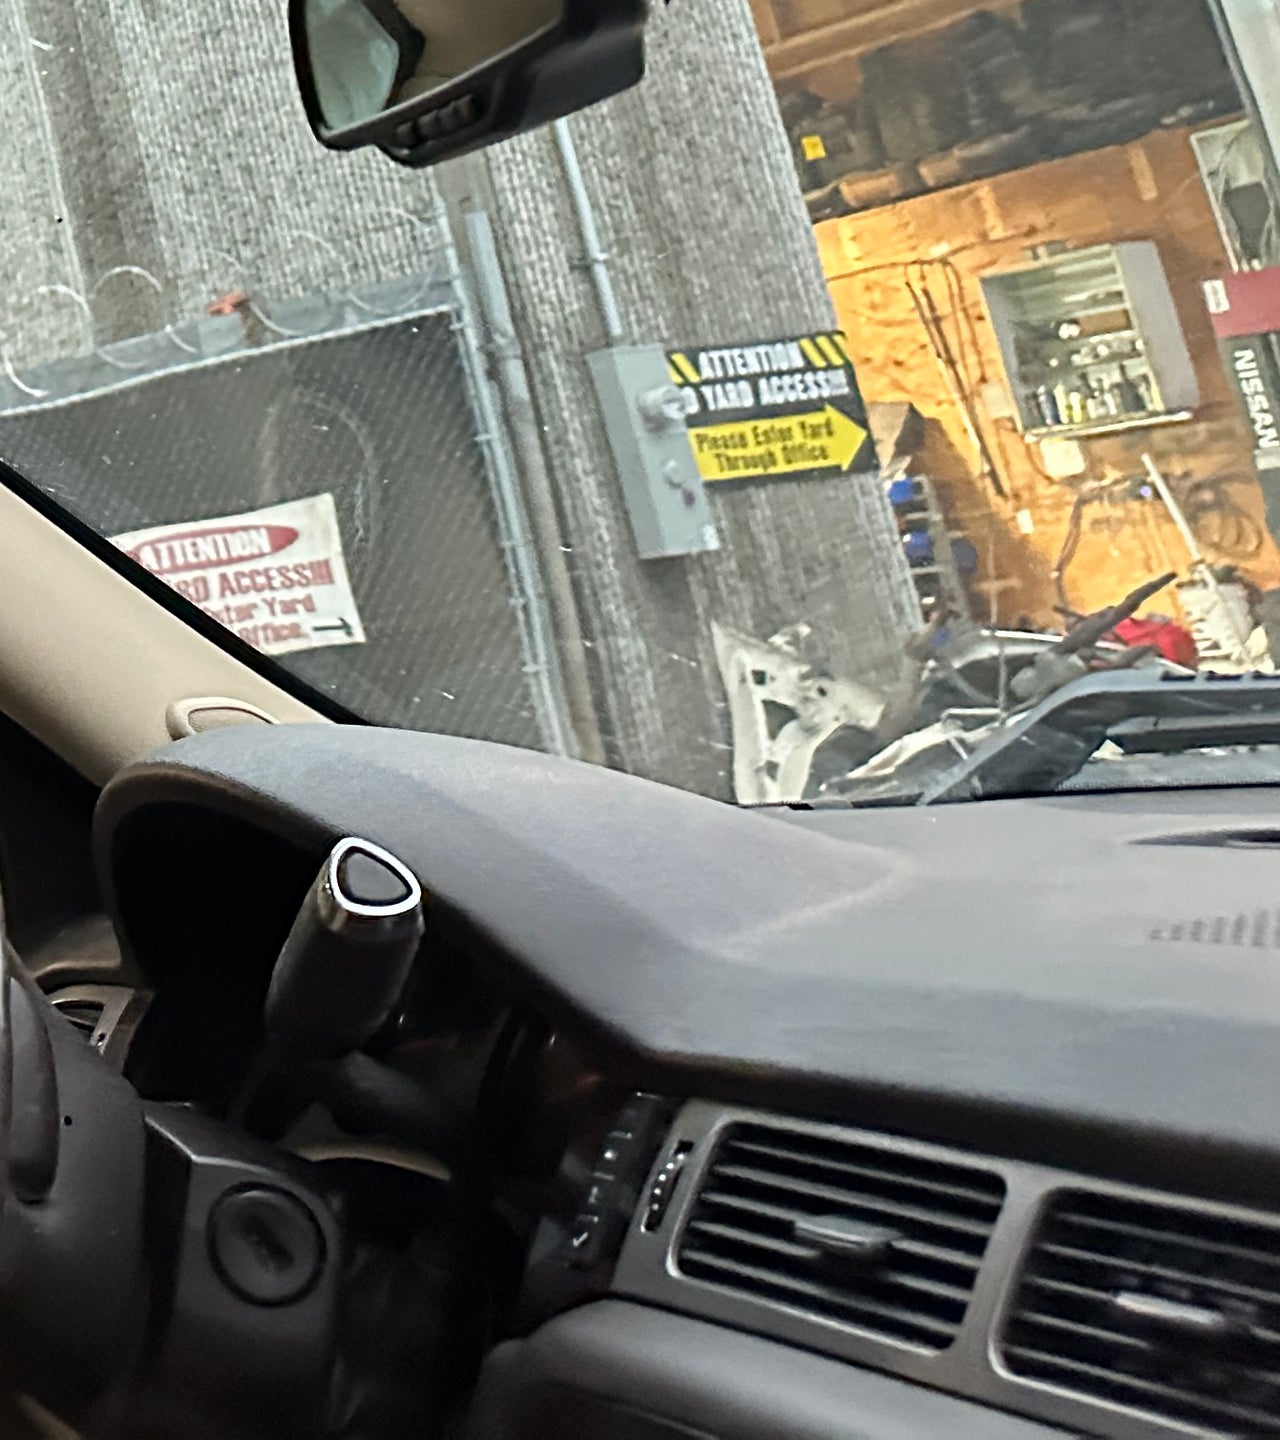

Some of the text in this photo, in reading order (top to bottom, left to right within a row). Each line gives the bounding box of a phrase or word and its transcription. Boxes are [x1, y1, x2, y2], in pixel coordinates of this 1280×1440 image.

[698, 341, 805, 381] ATTENTION
[700, 379, 755, 411] YARD
[1233, 348, 1280, 449] NISSAN
[694, 416, 834, 454] Please Enter Yard
[713, 446, 778, 472] Through
[140, 527, 271, 571] ATTENTION
[261, 594, 316, 615] Yard
